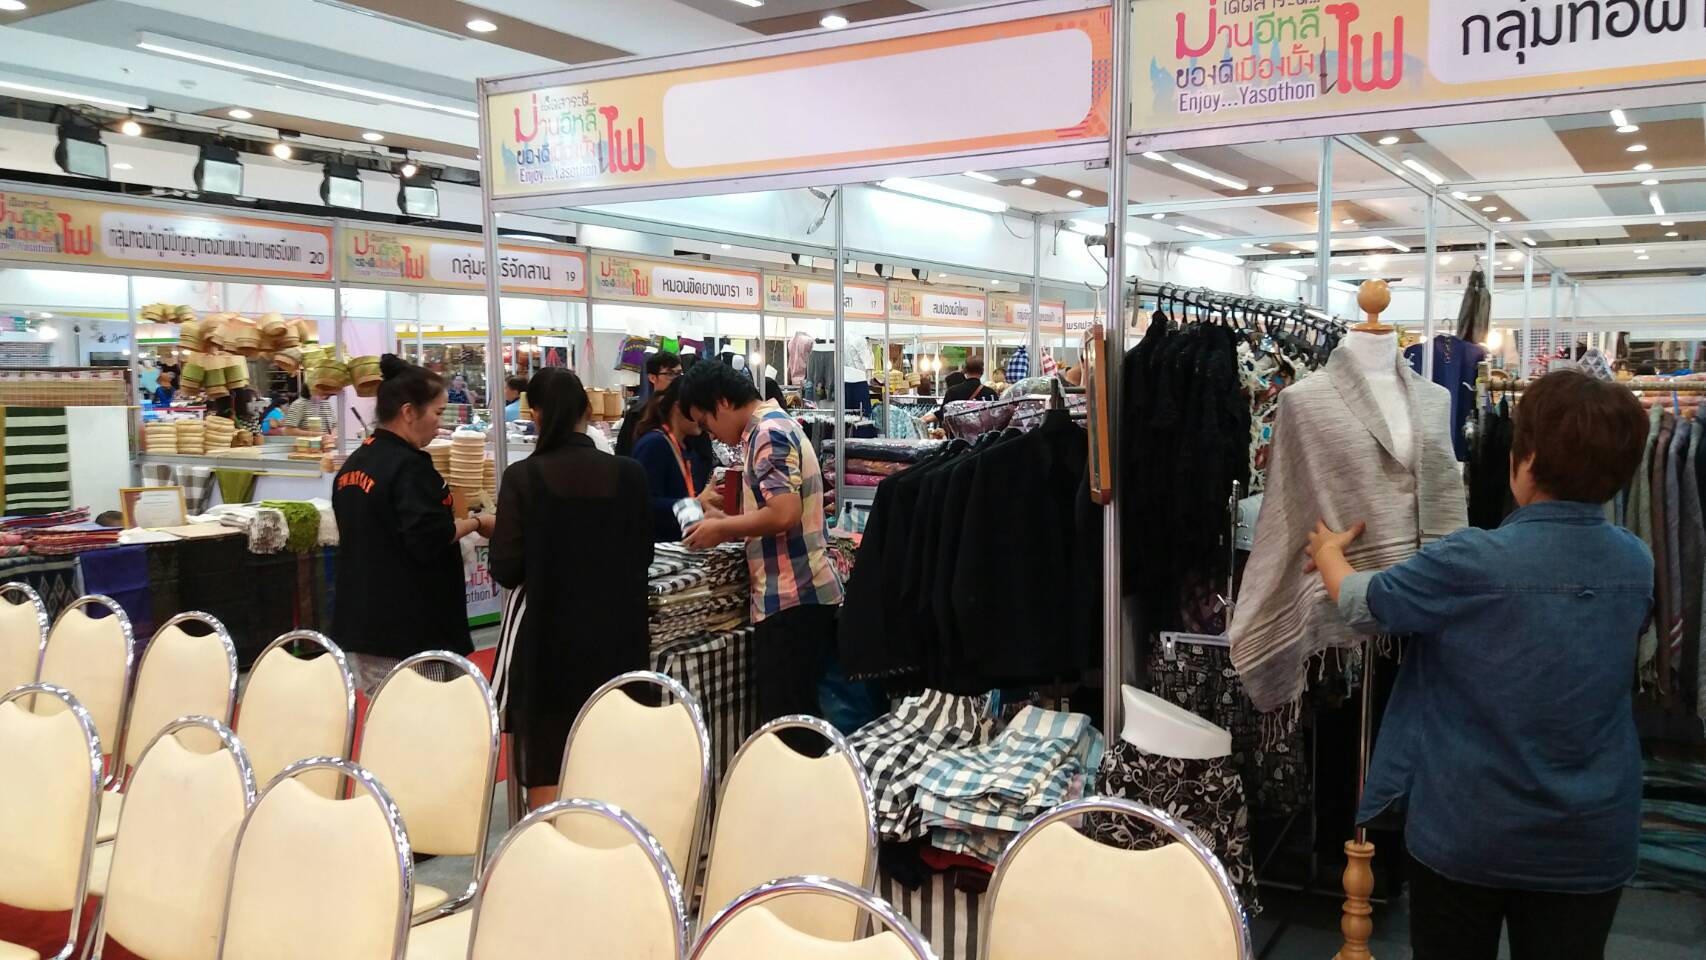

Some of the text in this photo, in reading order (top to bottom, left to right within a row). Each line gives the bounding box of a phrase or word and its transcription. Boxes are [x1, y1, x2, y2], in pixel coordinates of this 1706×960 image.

[1461, 0, 1706, 64] กลุมทอผ
[308, 251, 325, 265] 20
[451, 254, 576, 282] กลุ่มสรีจักสาน 19
[662, 277, 741, 299] หมอนขิดยางพารา
[746, 286, 754, 297] 18
